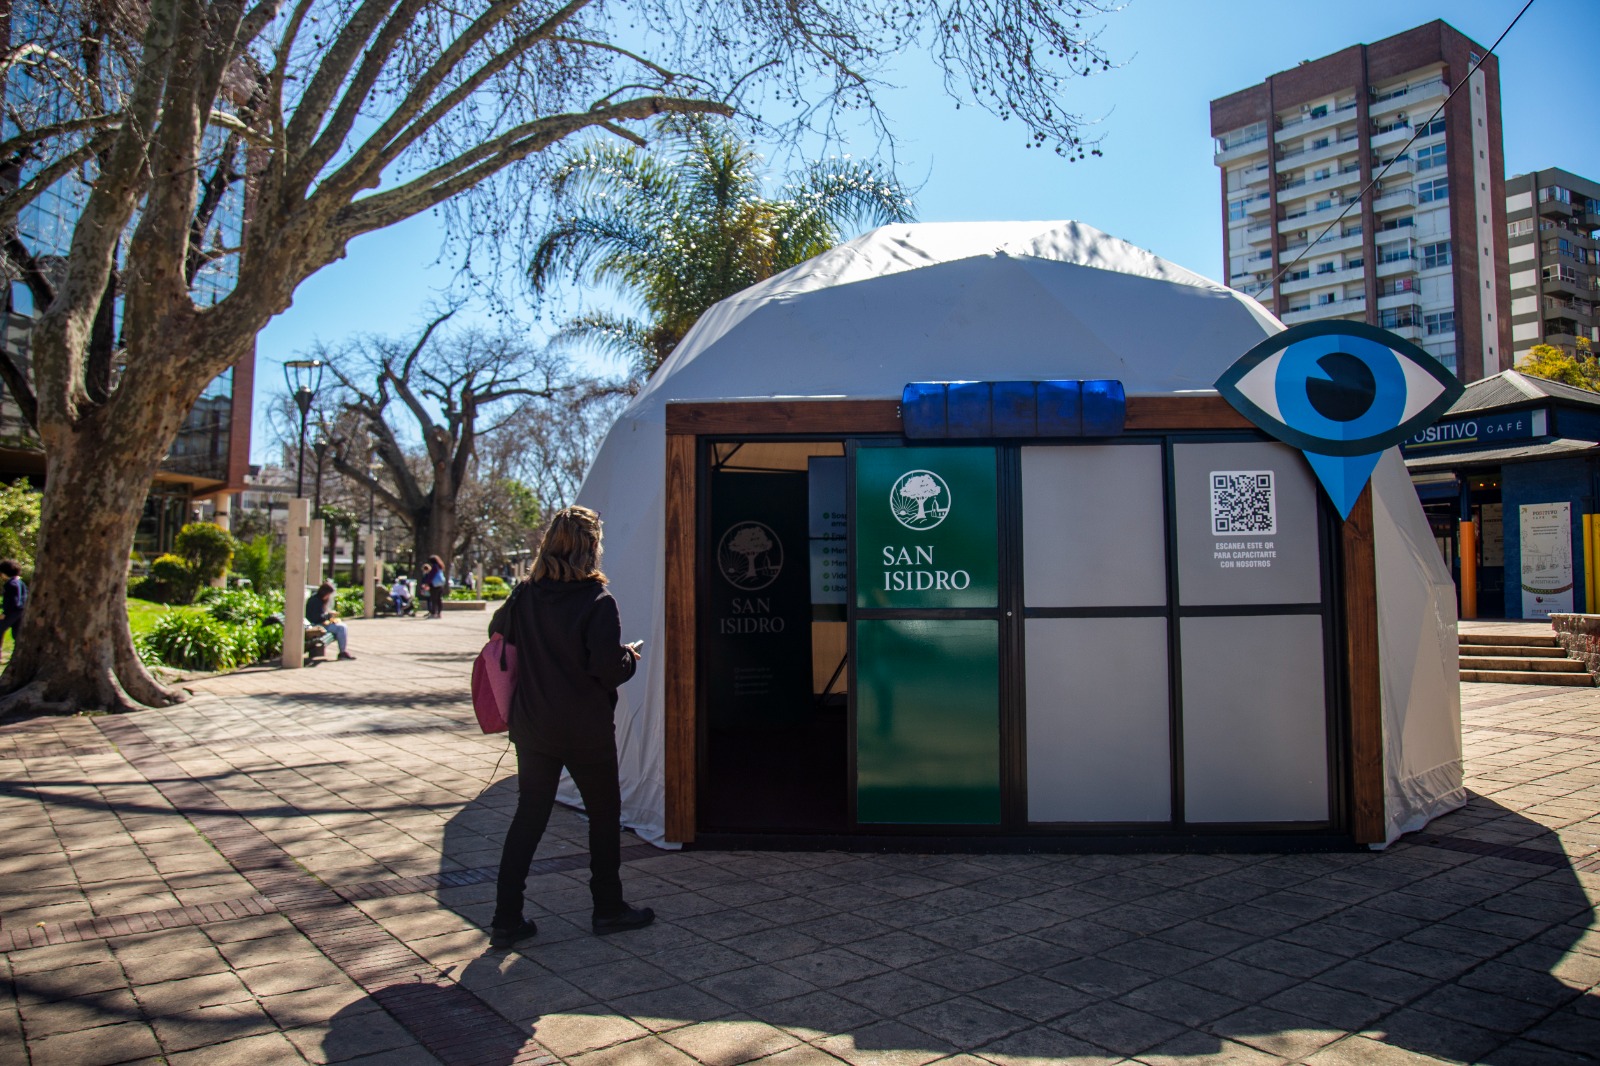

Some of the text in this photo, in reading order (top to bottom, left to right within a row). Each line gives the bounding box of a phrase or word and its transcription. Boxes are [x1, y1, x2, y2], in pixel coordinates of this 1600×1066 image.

[1405, 421, 1523, 444] OSITIVO CAFÉ
[883, 545, 934, 566] SAN
[1233, 551, 1277, 559] CAPACITARTE
[1236, 560, 1271, 568] NOSOTROS
[883, 570, 971, 591] ISIDRO
[732, 598, 770, 615] SAN
[720, 617, 785, 635] ISIDRO
